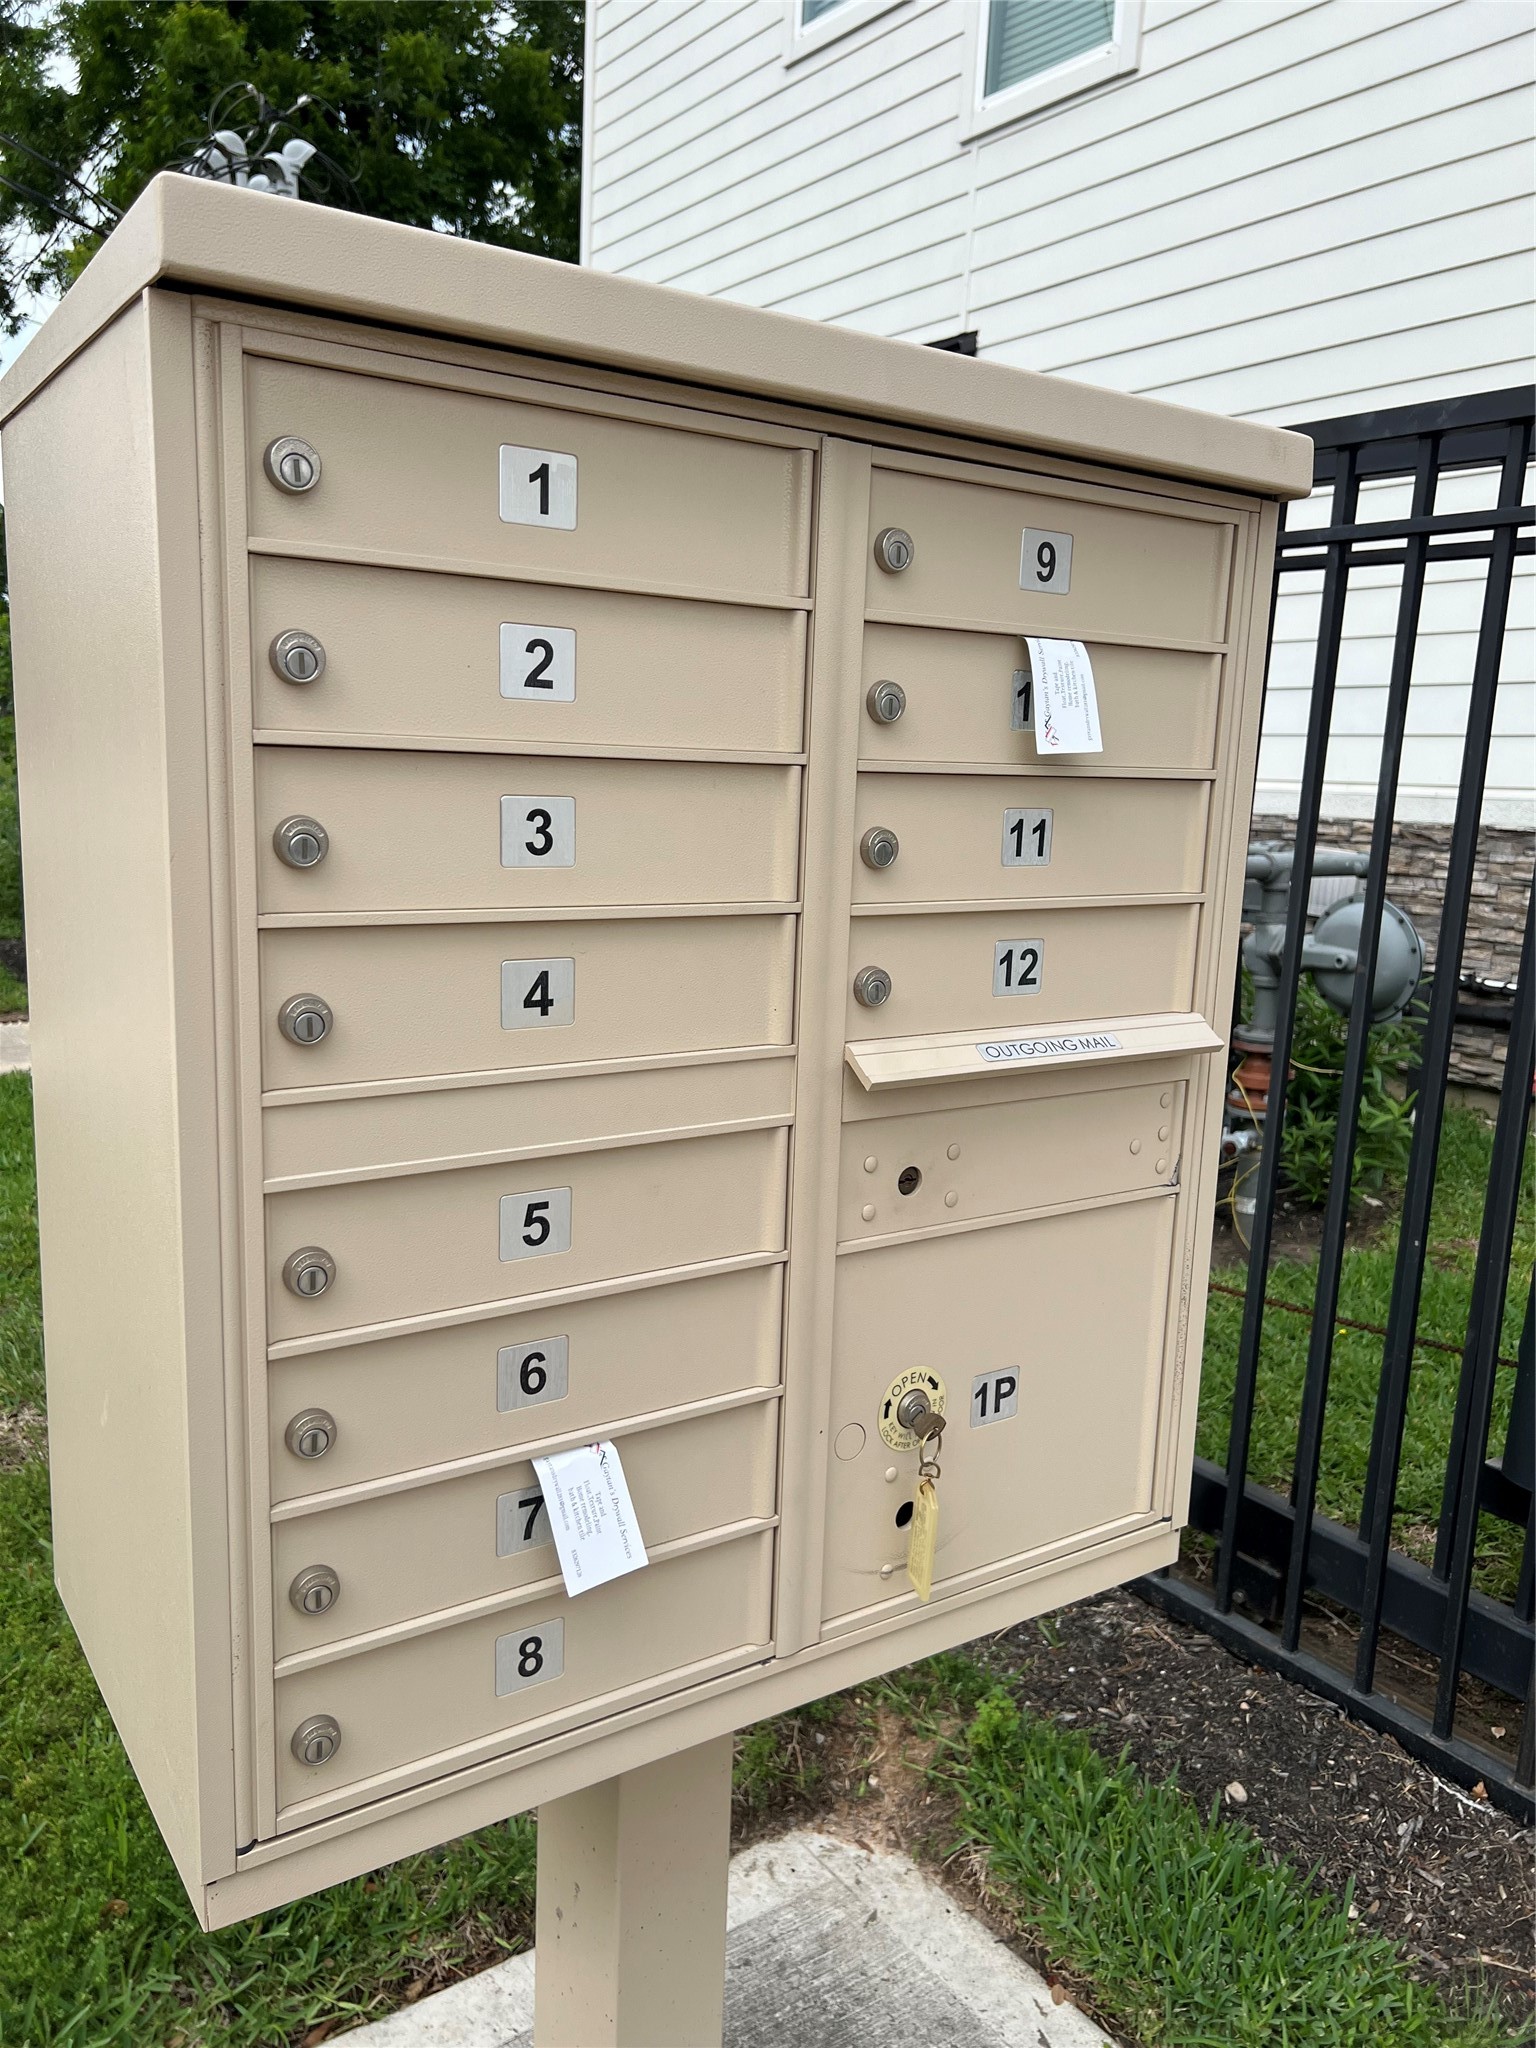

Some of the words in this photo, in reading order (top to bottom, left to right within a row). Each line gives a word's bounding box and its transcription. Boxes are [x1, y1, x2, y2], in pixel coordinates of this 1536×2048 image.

[528, 463, 550, 516] 1
[1036, 541, 1056, 583] 9
[523, 638, 554, 690] 2
[1036, 639, 1044, 655] Servi
[1039, 657, 1048, 684] Drywall
[1016, 681, 1031, 722] 1
[525, 808, 554, 856] 3
[1009, 818, 1048, 858] 11
[998, 948, 1040, 987] 12
[523, 970, 554, 1017] 4
[985, 1039, 1078, 1058] OUTGOING
[1078, 1036, 1116, 1050] MAIL
[522, 1200, 551, 1247] 5
[519, 1351, 547, 1395] 6
[891, 1371, 927, 1397] OPEN
[974, 1376, 1017, 1418] 1P
[881, 1426, 894, 1444] LOCK
[893, 1440, 911, 1449] AFTER
[888, 1421, 897, 1434] KEY
[518, 1495, 545, 1541] 7
[594, 1492, 604, 1506] Tape
[598, 1506, 607, 1517] and
[602, 1463, 616, 1496] Gaytan's
[612, 1498, 625, 1527] Drywall
[619, 1530, 633, 1559] Services
[517, 1636, 544, 1678] 8
